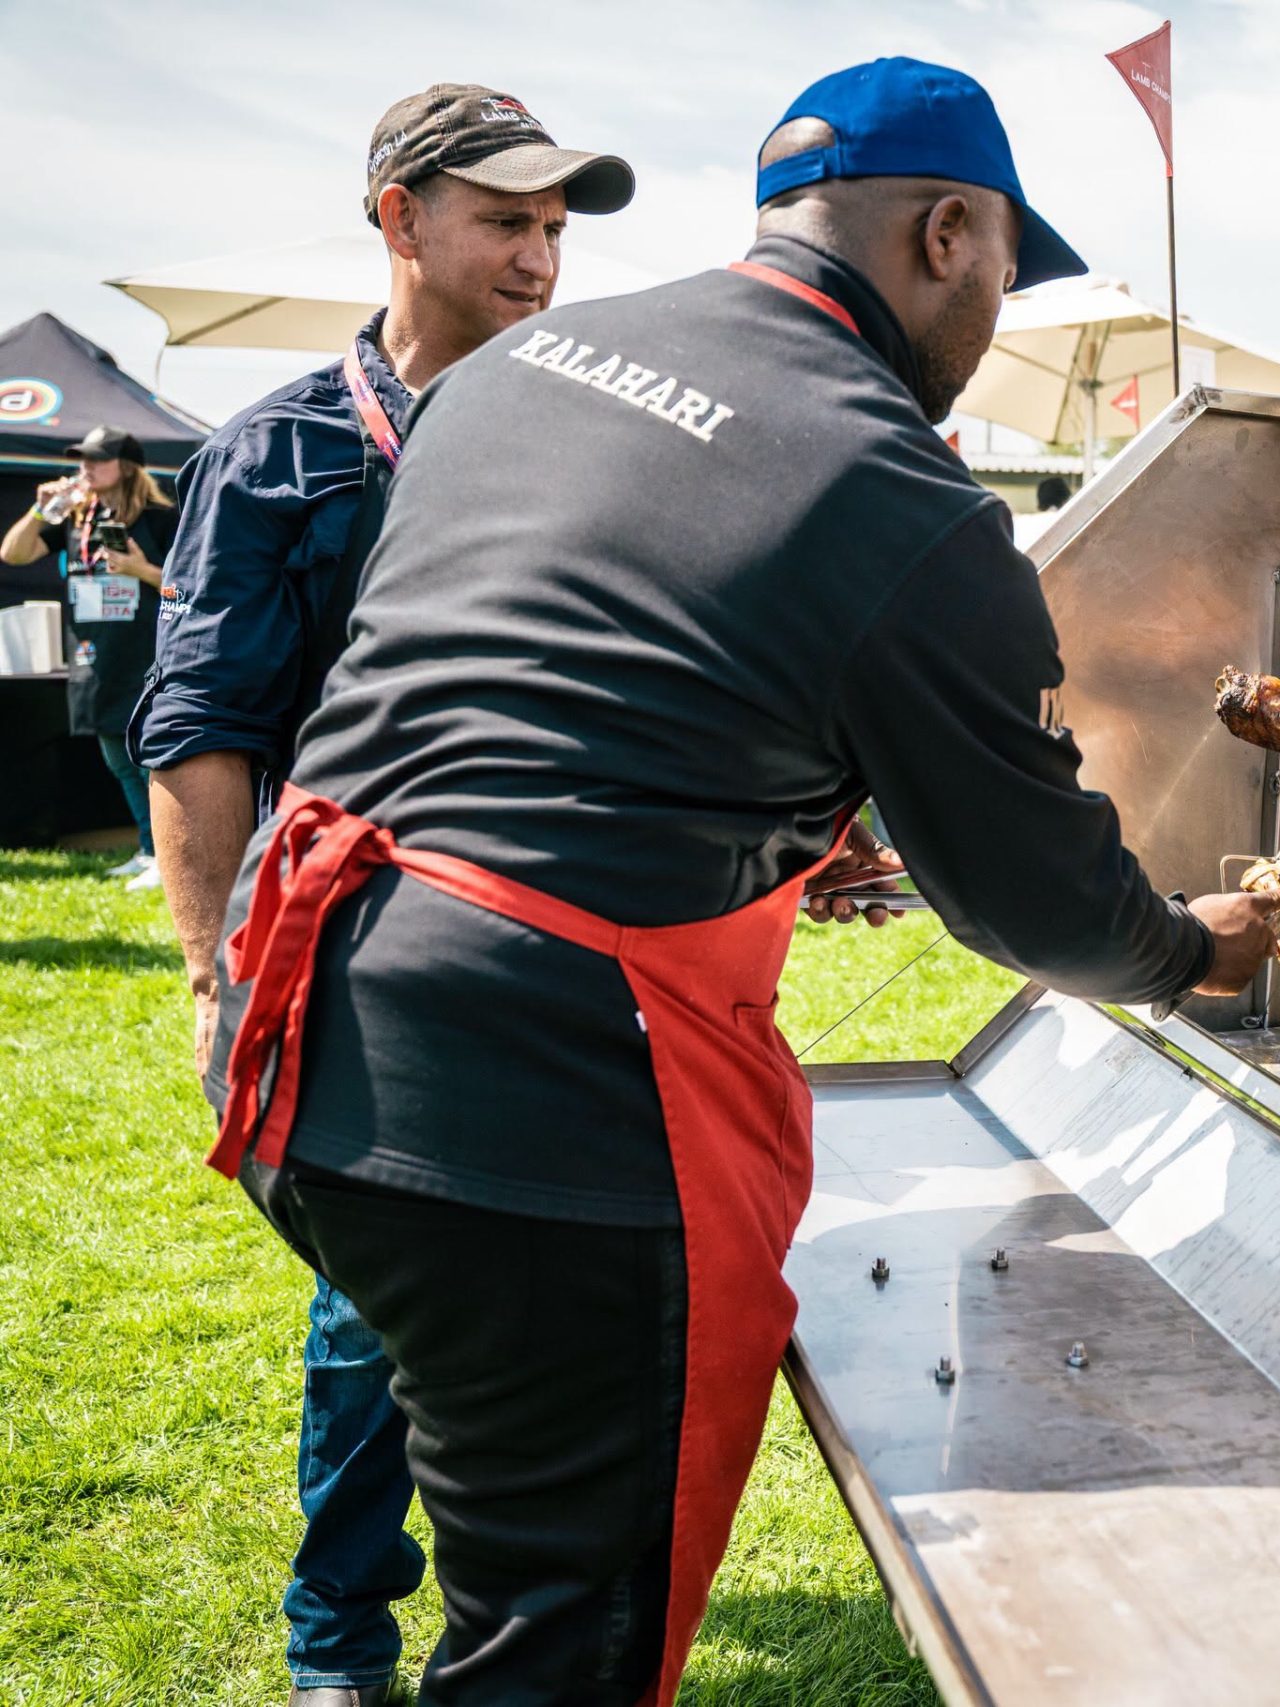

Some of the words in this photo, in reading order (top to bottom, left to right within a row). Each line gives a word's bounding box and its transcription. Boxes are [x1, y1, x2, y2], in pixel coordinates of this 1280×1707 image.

[1131, 68, 1150, 88] LAMB
[481, 111, 519, 122] LAMB
[508, 329, 735, 443] KALAHARI
